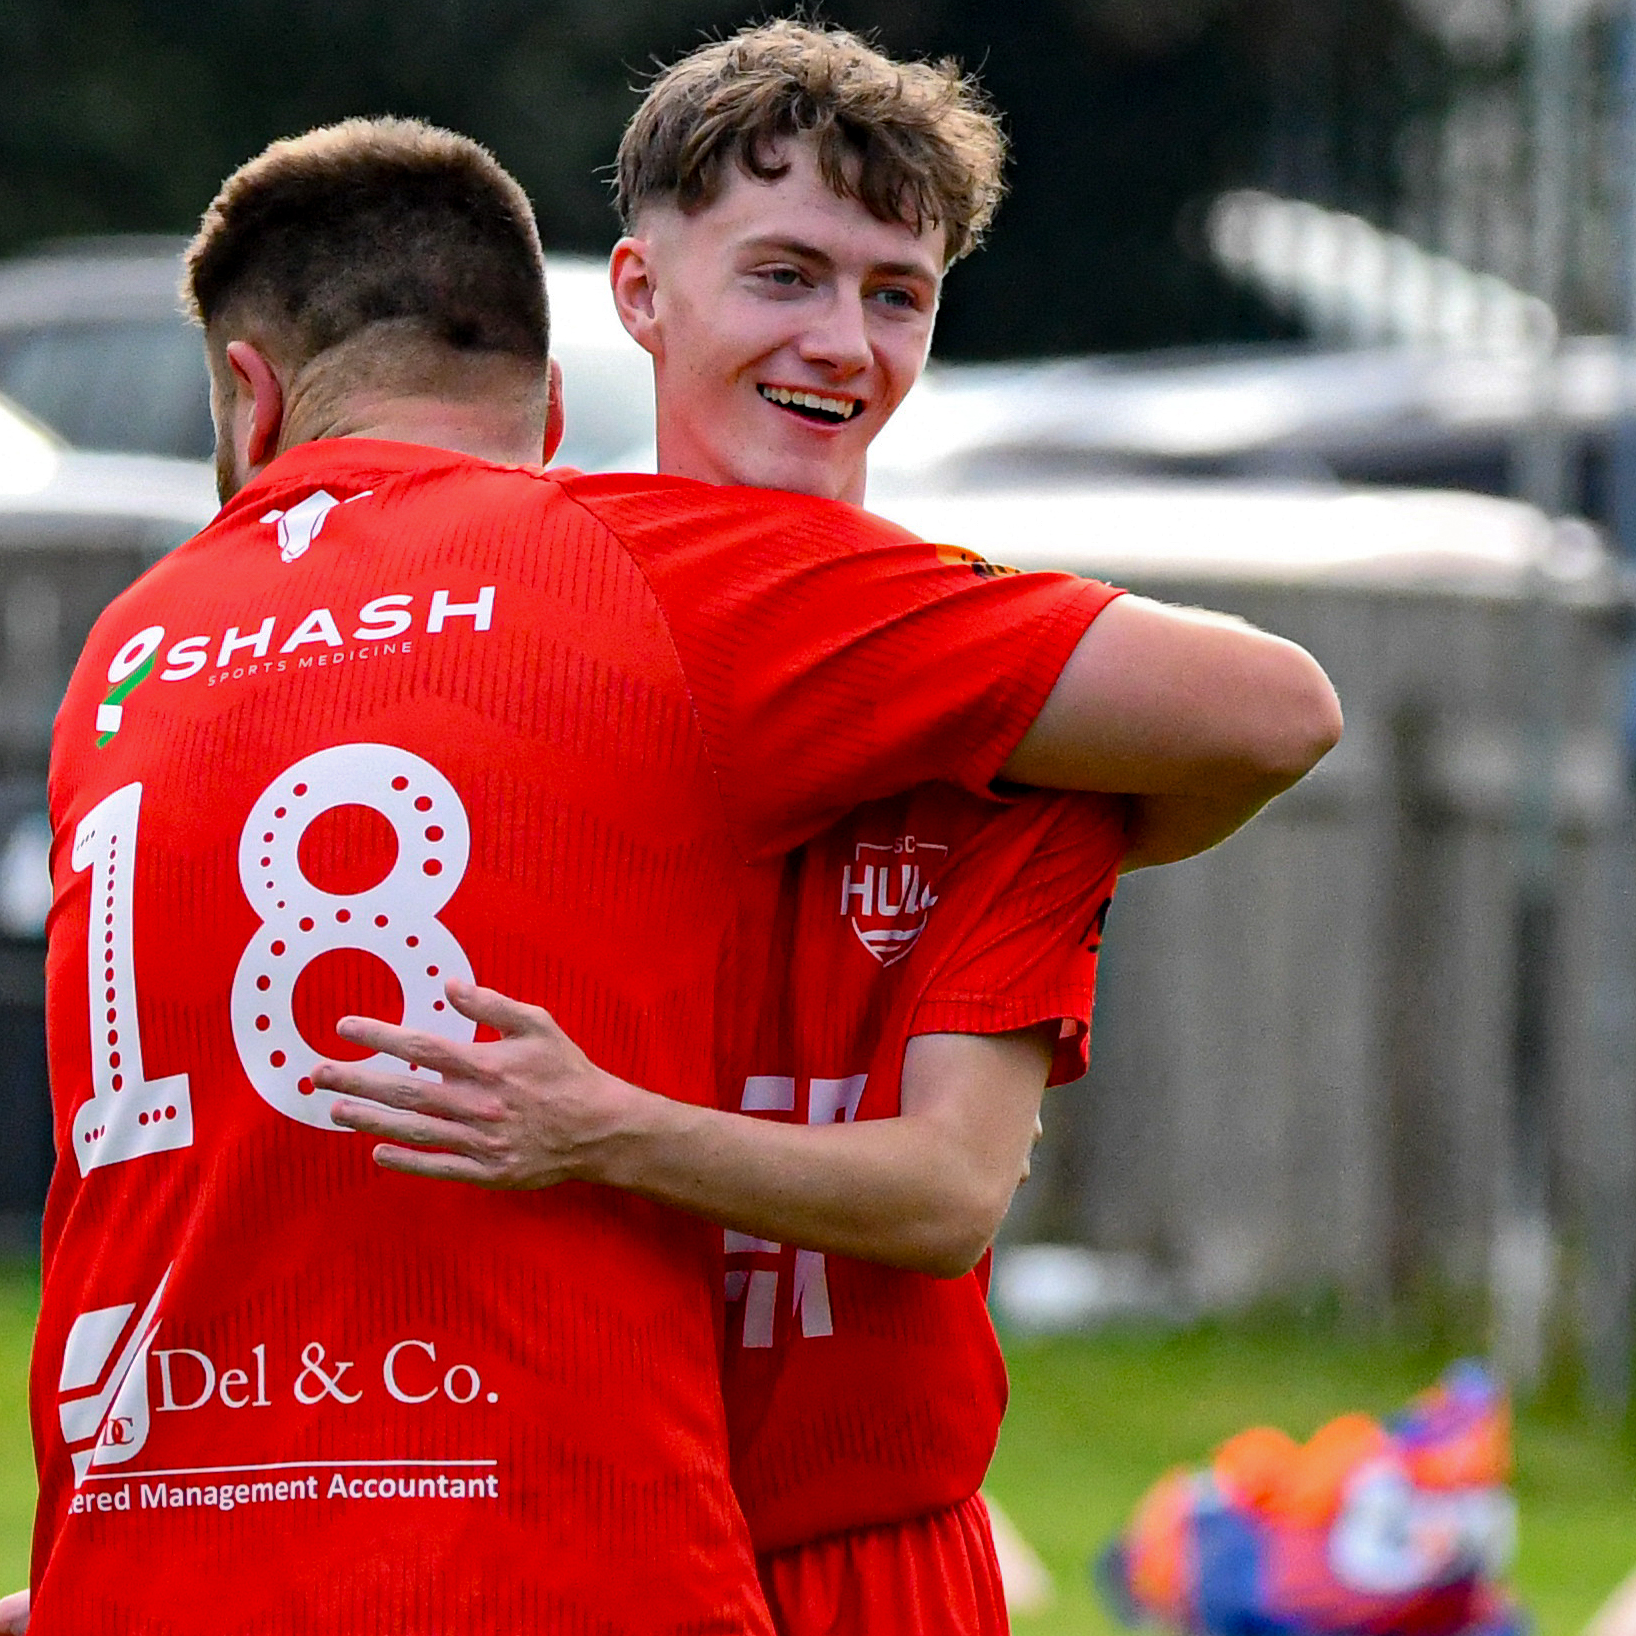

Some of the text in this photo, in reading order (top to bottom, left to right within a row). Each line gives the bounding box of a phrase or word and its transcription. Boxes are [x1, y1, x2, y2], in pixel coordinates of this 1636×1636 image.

[160, 586, 496, 681] SHASH
[208, 641, 413, 687] SPORTS MEDICINE
[72, 742, 478, 1178] 18
[151, 1339, 499, 1413] Del & Co.
[68, 1473, 499, 1516] ered Management Accountant
